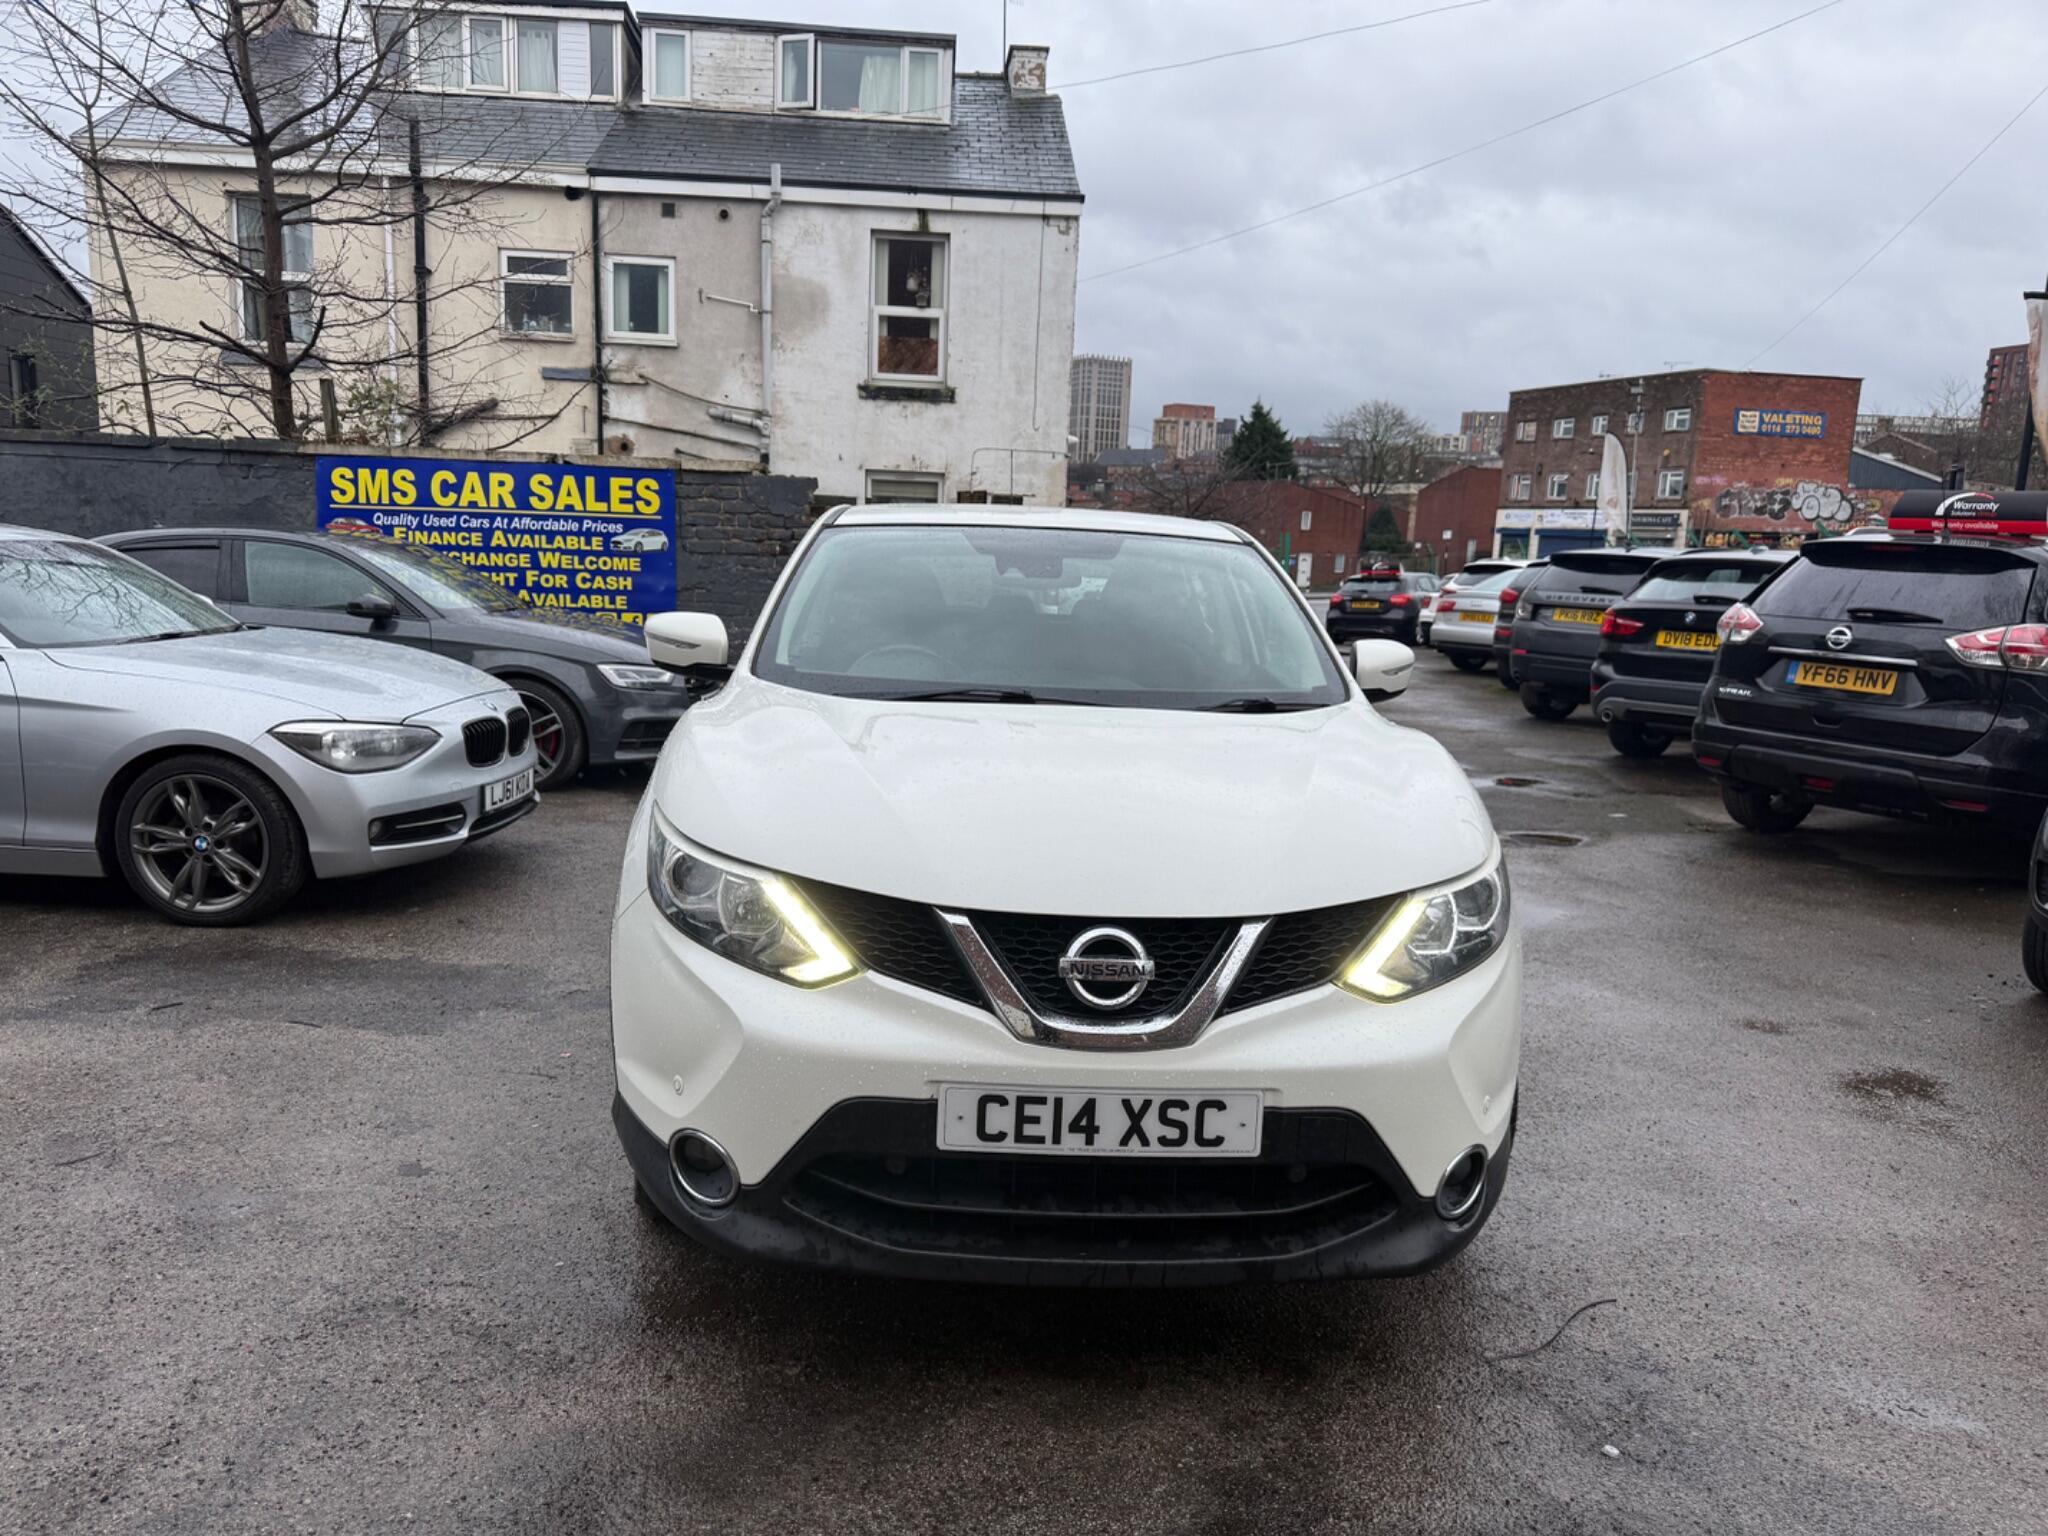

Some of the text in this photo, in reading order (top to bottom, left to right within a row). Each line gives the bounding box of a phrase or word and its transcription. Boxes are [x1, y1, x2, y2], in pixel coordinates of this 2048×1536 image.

[1761, 423, 1781, 433] 0114
[1762, 413, 1822, 425] VALETING
[330, 466, 661, 514] SMS CAR SALES
[1953, 500, 2000, 512] Warranty
[373, 512, 623, 533] Quality Used Cars At Affordable Prices
[1964, 520, 1998, 530] available
[393, 527, 604, 550] FINANCE AVAILABLE
[538, 551, 641, 571] WELCOME
[526, 570, 568, 588] FOR
[575, 573, 632, 590] CASH
[518, 589, 628, 609] AVAILABLE
[1546, 594, 1615, 603] DISCOVERY
[1663, 631, 1692, 645] DV18
[1802, 664, 1894, 690] YF66 HNV
[491, 778, 514, 806] LJ61
[1069, 961, 1146, 977] NISSAN
[976, 1094, 1227, 1148] CE14 XSC
